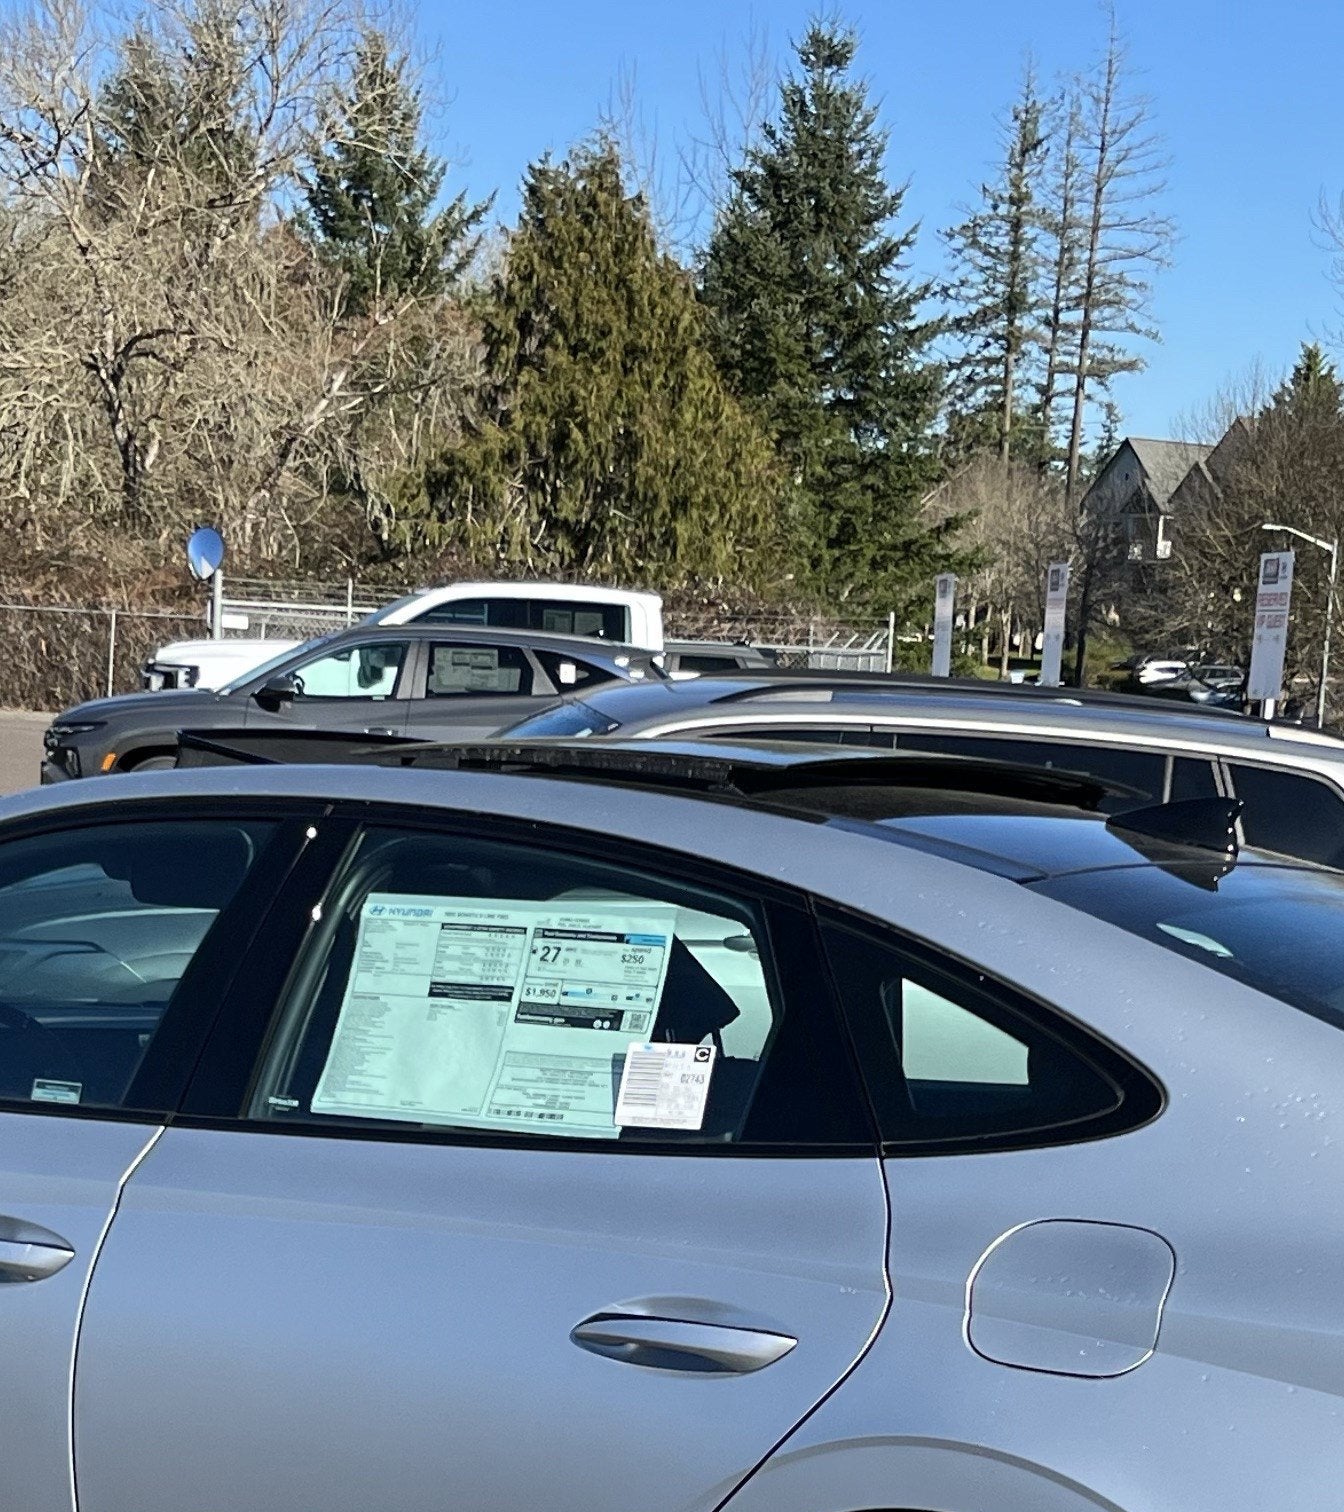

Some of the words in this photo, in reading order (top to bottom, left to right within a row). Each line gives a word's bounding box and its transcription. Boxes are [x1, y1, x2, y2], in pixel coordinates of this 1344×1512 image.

[388, 907, 434, 918] HYUNDAI
[540, 946, 561, 963] 27
[621, 953, 644, 965] $250
